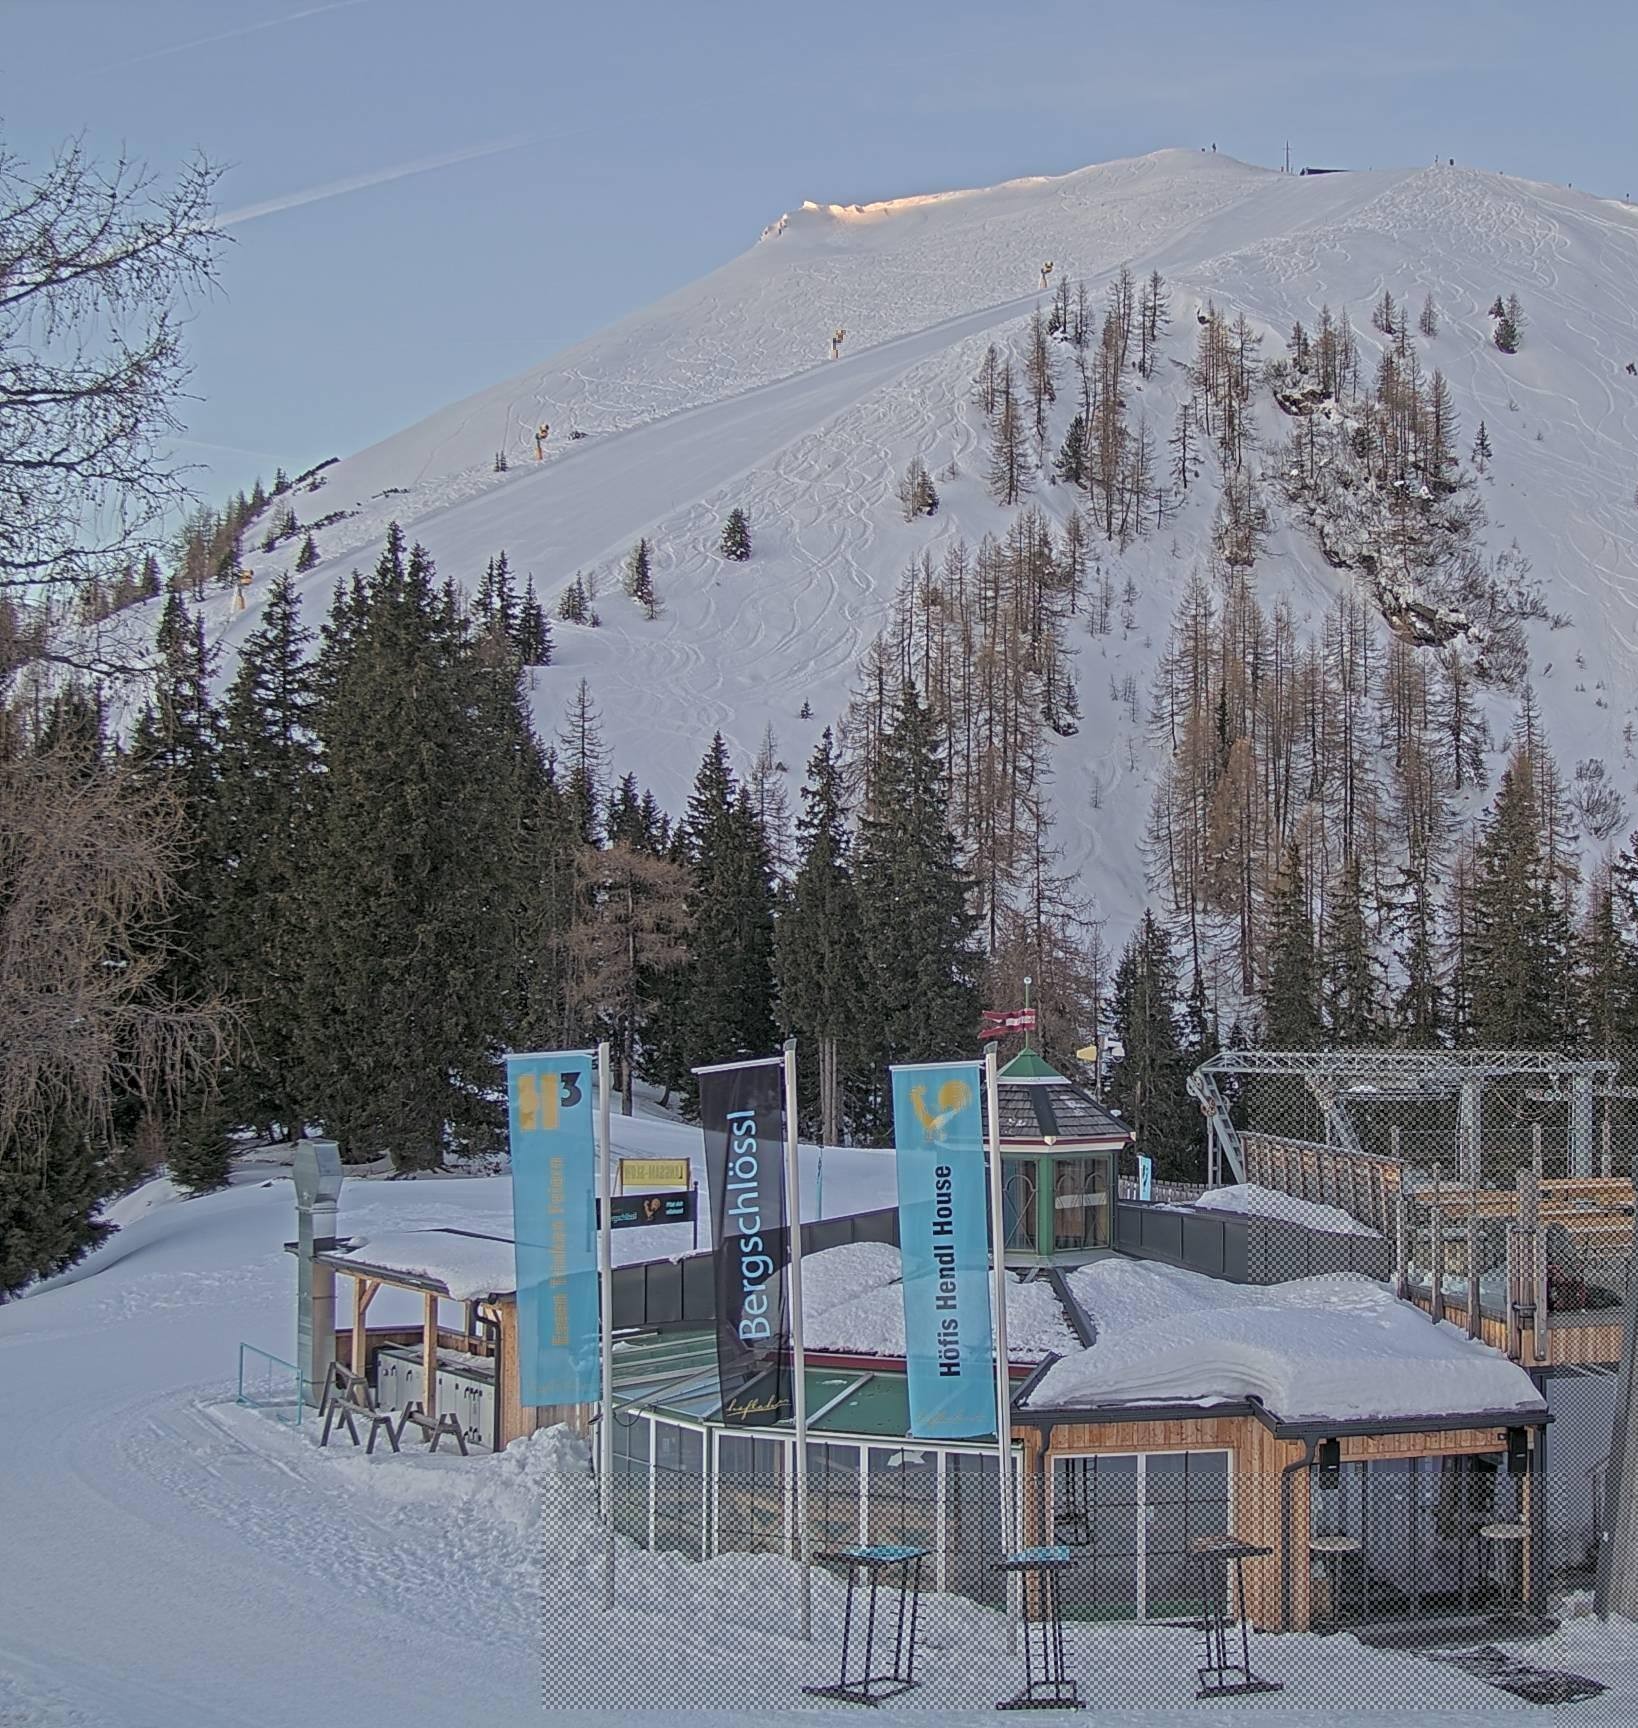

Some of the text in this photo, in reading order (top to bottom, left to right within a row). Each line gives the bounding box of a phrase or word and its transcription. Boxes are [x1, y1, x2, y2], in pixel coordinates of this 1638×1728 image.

[726, 1110, 774, 1340] Bergschlössl
[932, 1165, 961, 1377] Höfis Hendl House
